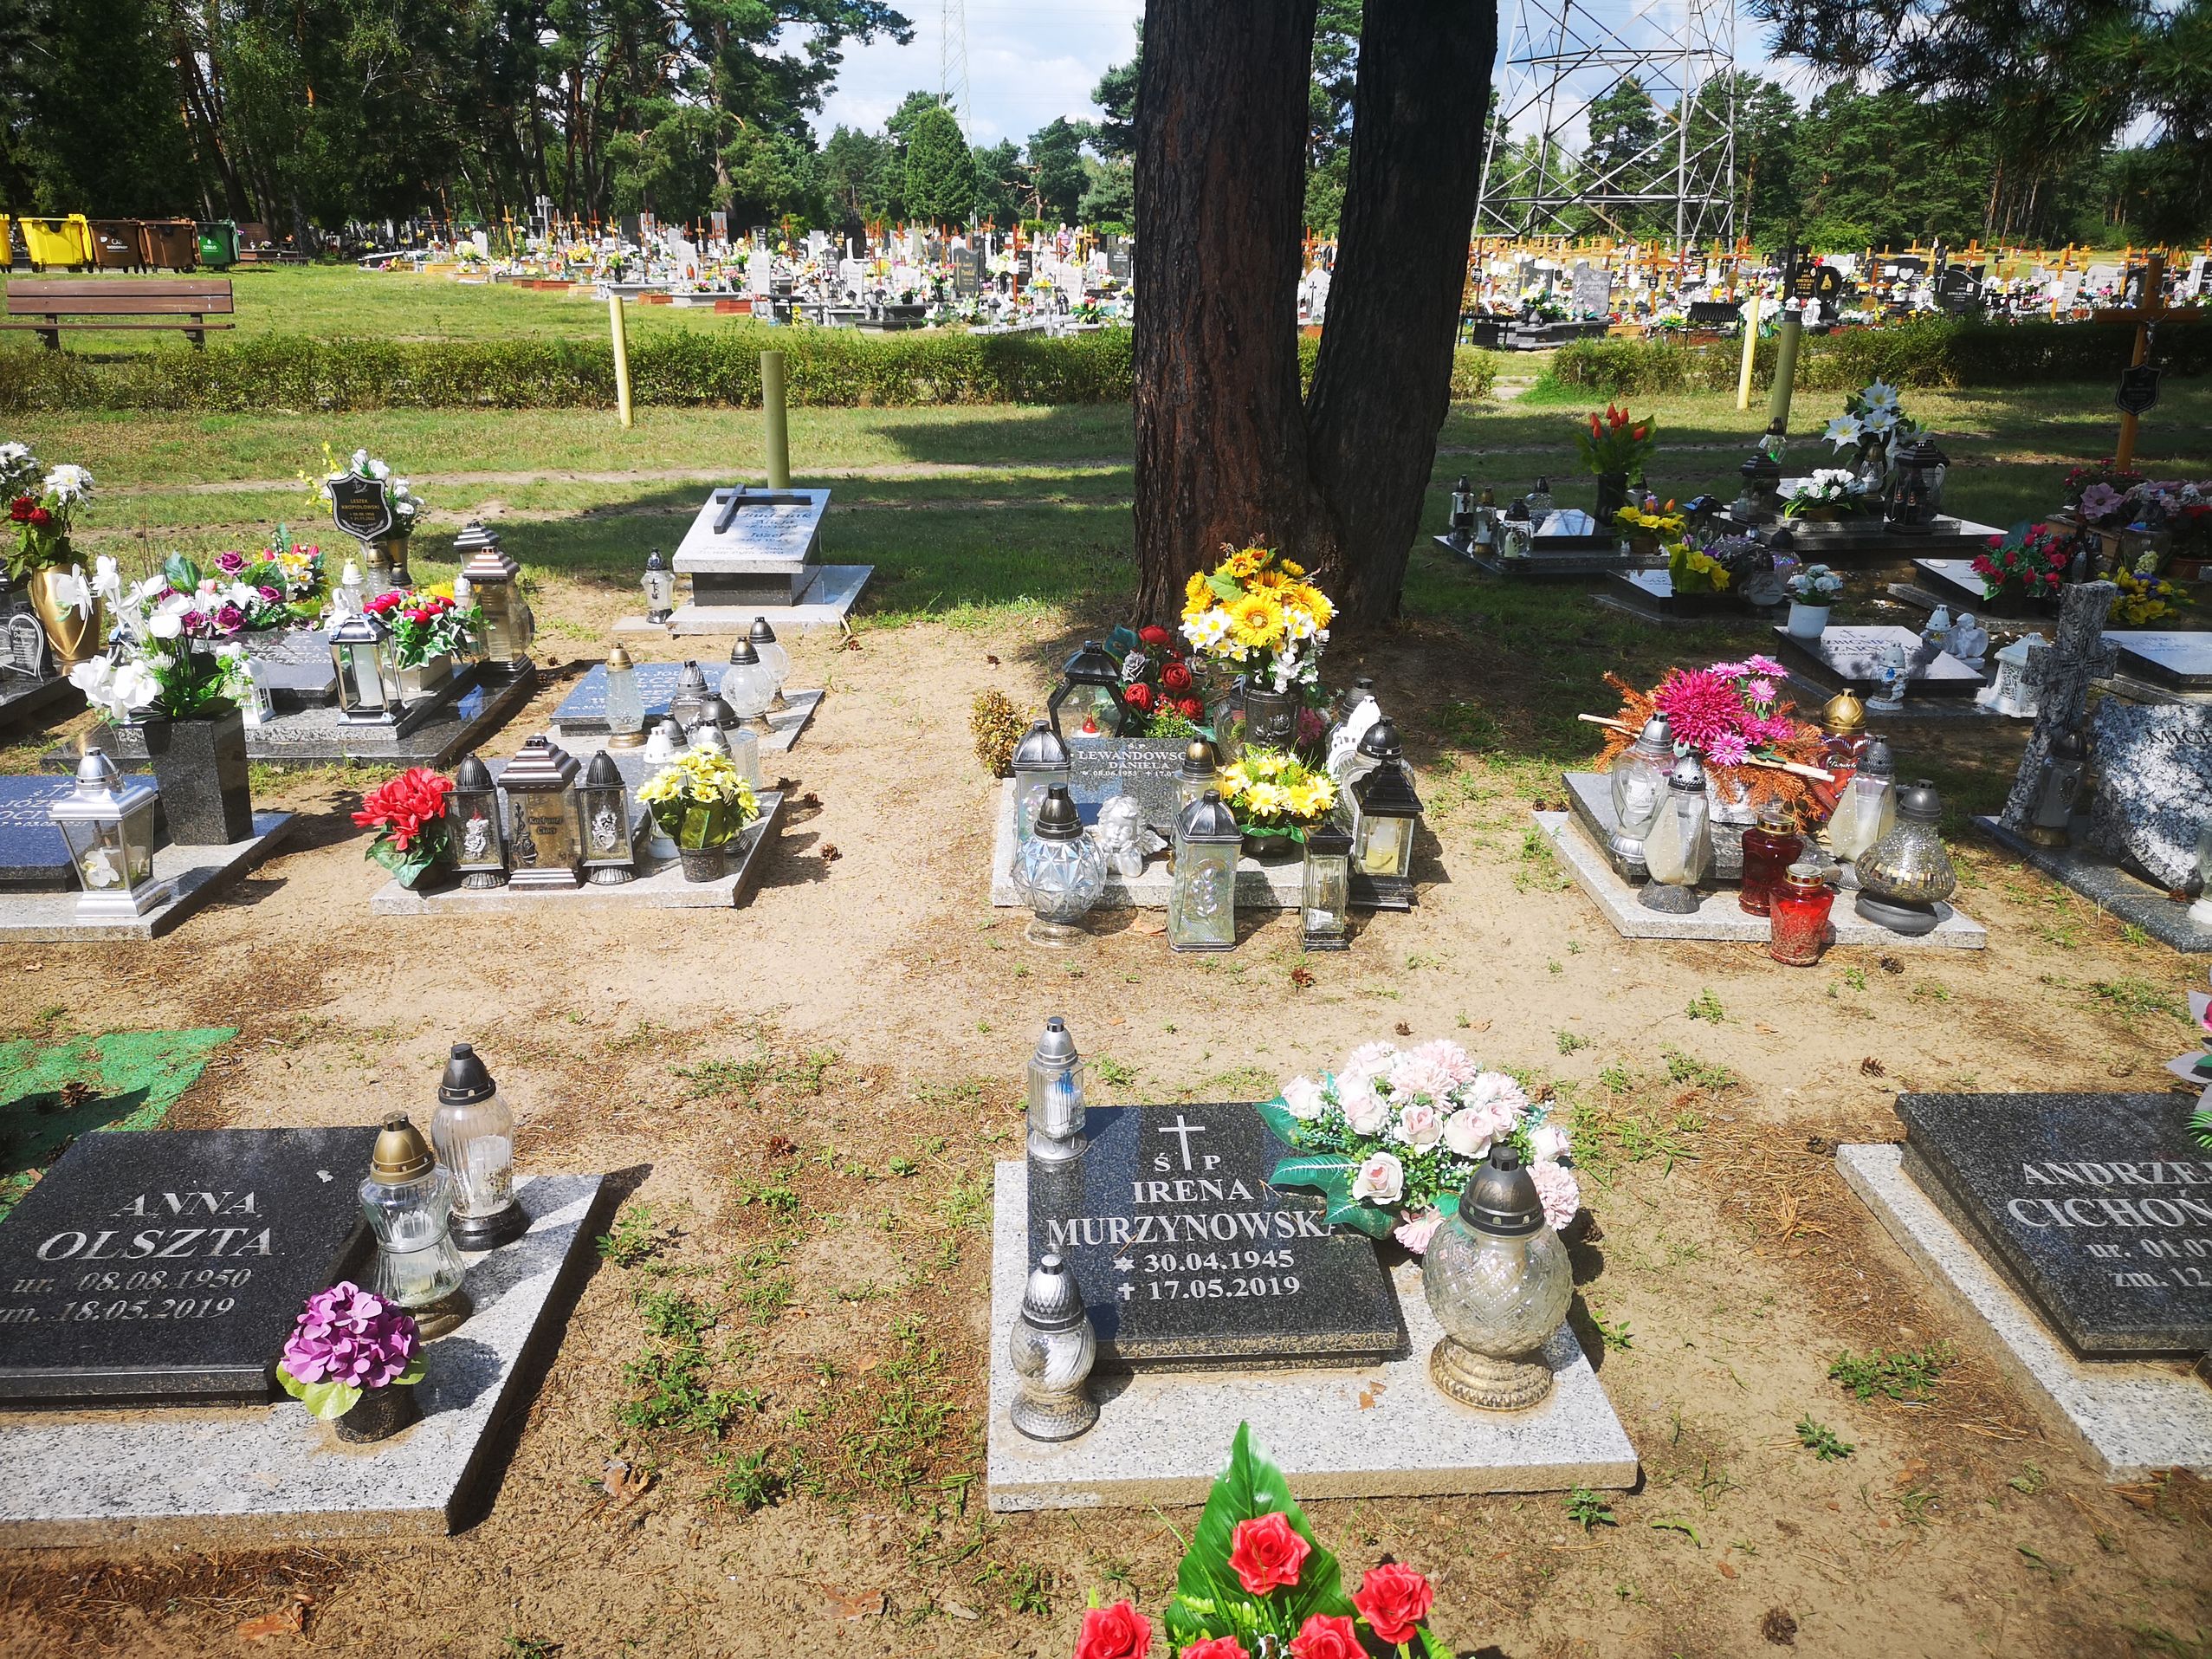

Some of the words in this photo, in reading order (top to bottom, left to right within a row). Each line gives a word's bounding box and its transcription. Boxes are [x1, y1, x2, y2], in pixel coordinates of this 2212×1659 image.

[1077, 750, 1187, 761] LEWANDOWSC
[1108, 761, 1170, 769] DANIELA
[1154, 1152, 1172, 1172] Ś
[1203, 1155, 1221, 1170] P
[107, 1189, 258, 1217] ANNA
[1130, 1178, 1255, 1203] IRENA
[36, 1227, 273, 1261] OLSZTA
[2084, 1244, 2131, 1258] ur.
[1143, 1248, 1296, 1273] 30.04.1945
[11, 1278, 55, 1293] ur.
[76, 1267, 252, 1292] 08.08.1950
[1148, 1275, 1301, 1300] 17.05.2019
[2108, 1273, 2169, 1287] zm.
[50, 1297, 236, 1323] 18.05.2019
